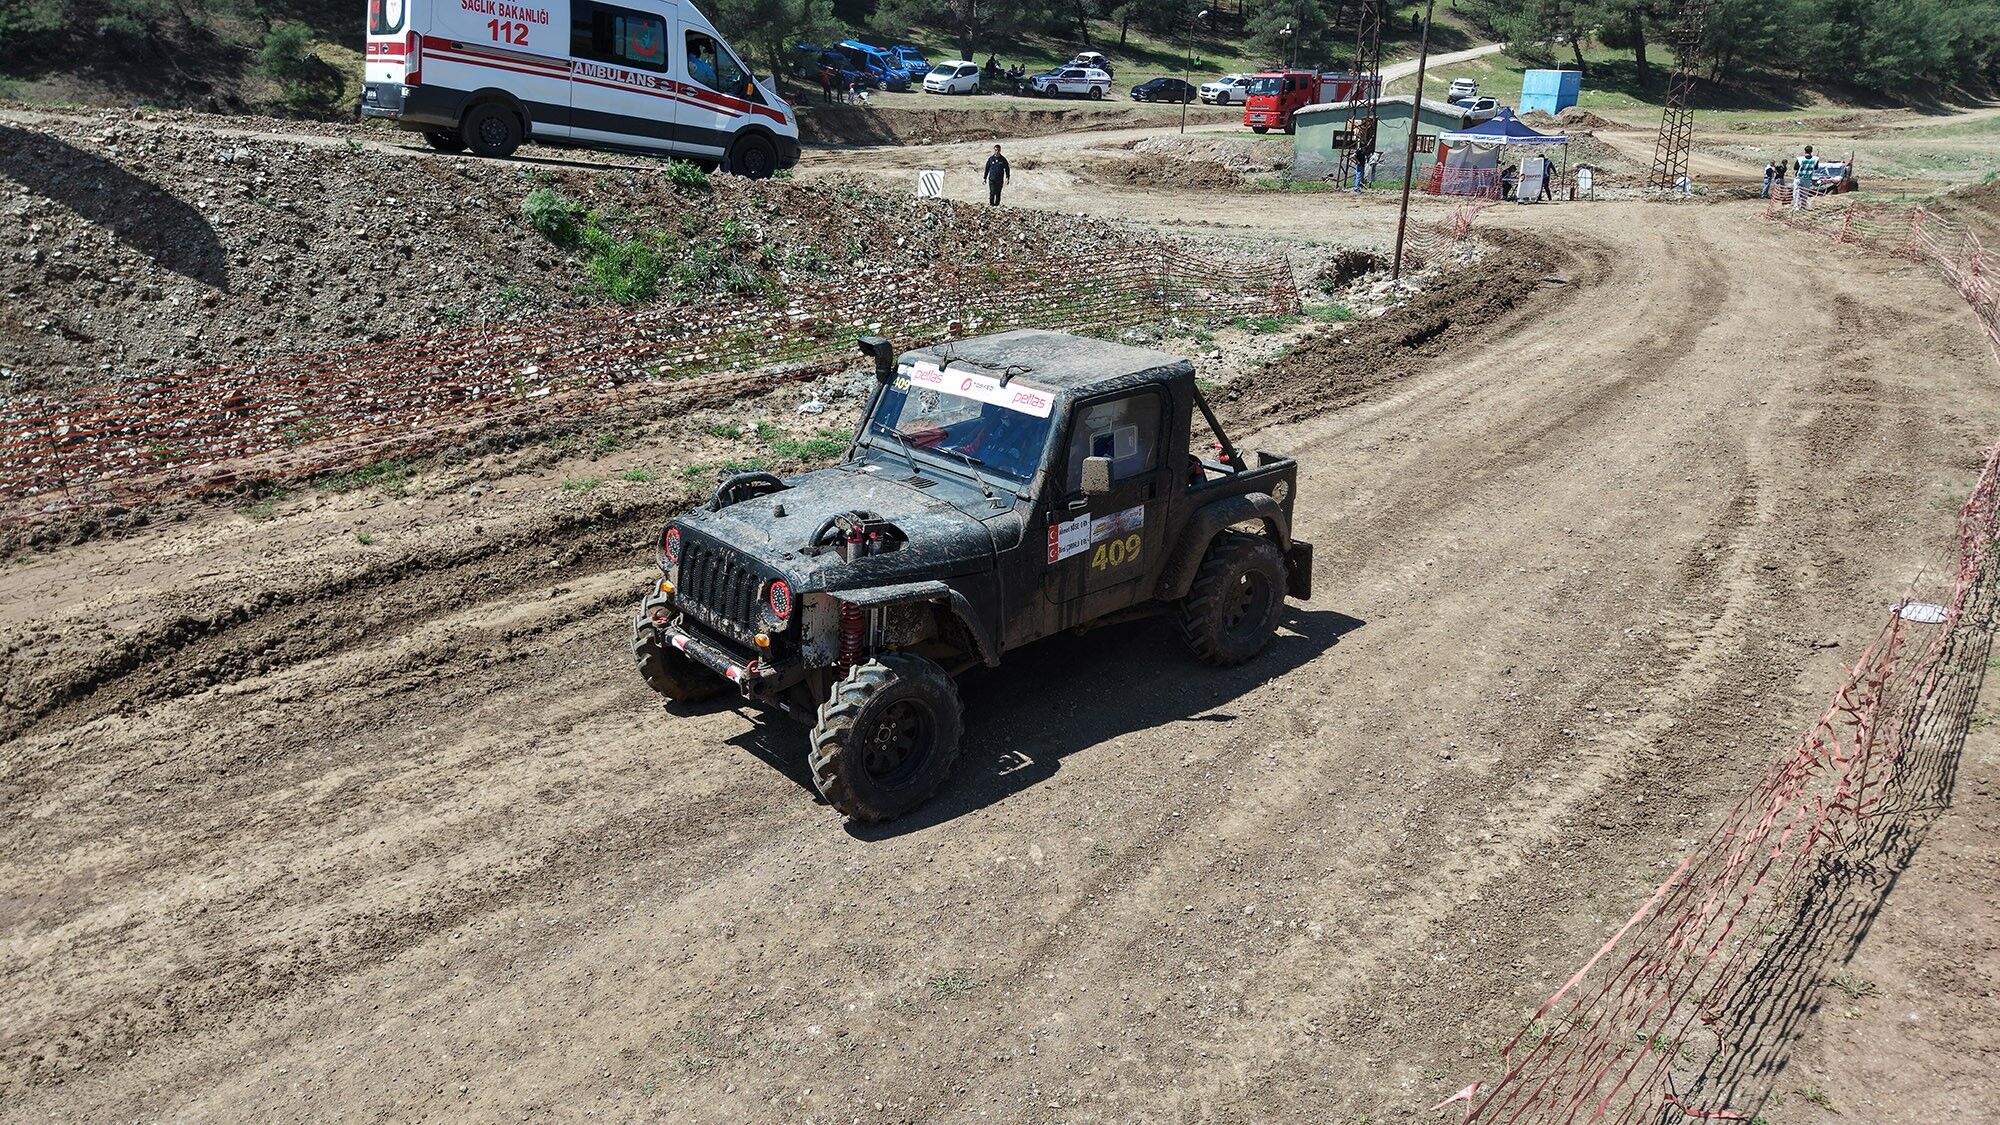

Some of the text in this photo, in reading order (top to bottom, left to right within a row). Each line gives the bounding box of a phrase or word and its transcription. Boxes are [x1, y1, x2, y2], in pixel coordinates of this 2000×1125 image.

[499, 3, 549, 25] BAKANLIĞI
[487, 18, 529, 46] 112
[573, 61, 657, 88] AMBULANS
[892, 376, 911, 390] 409
[1091, 534, 1141, 571] 409
